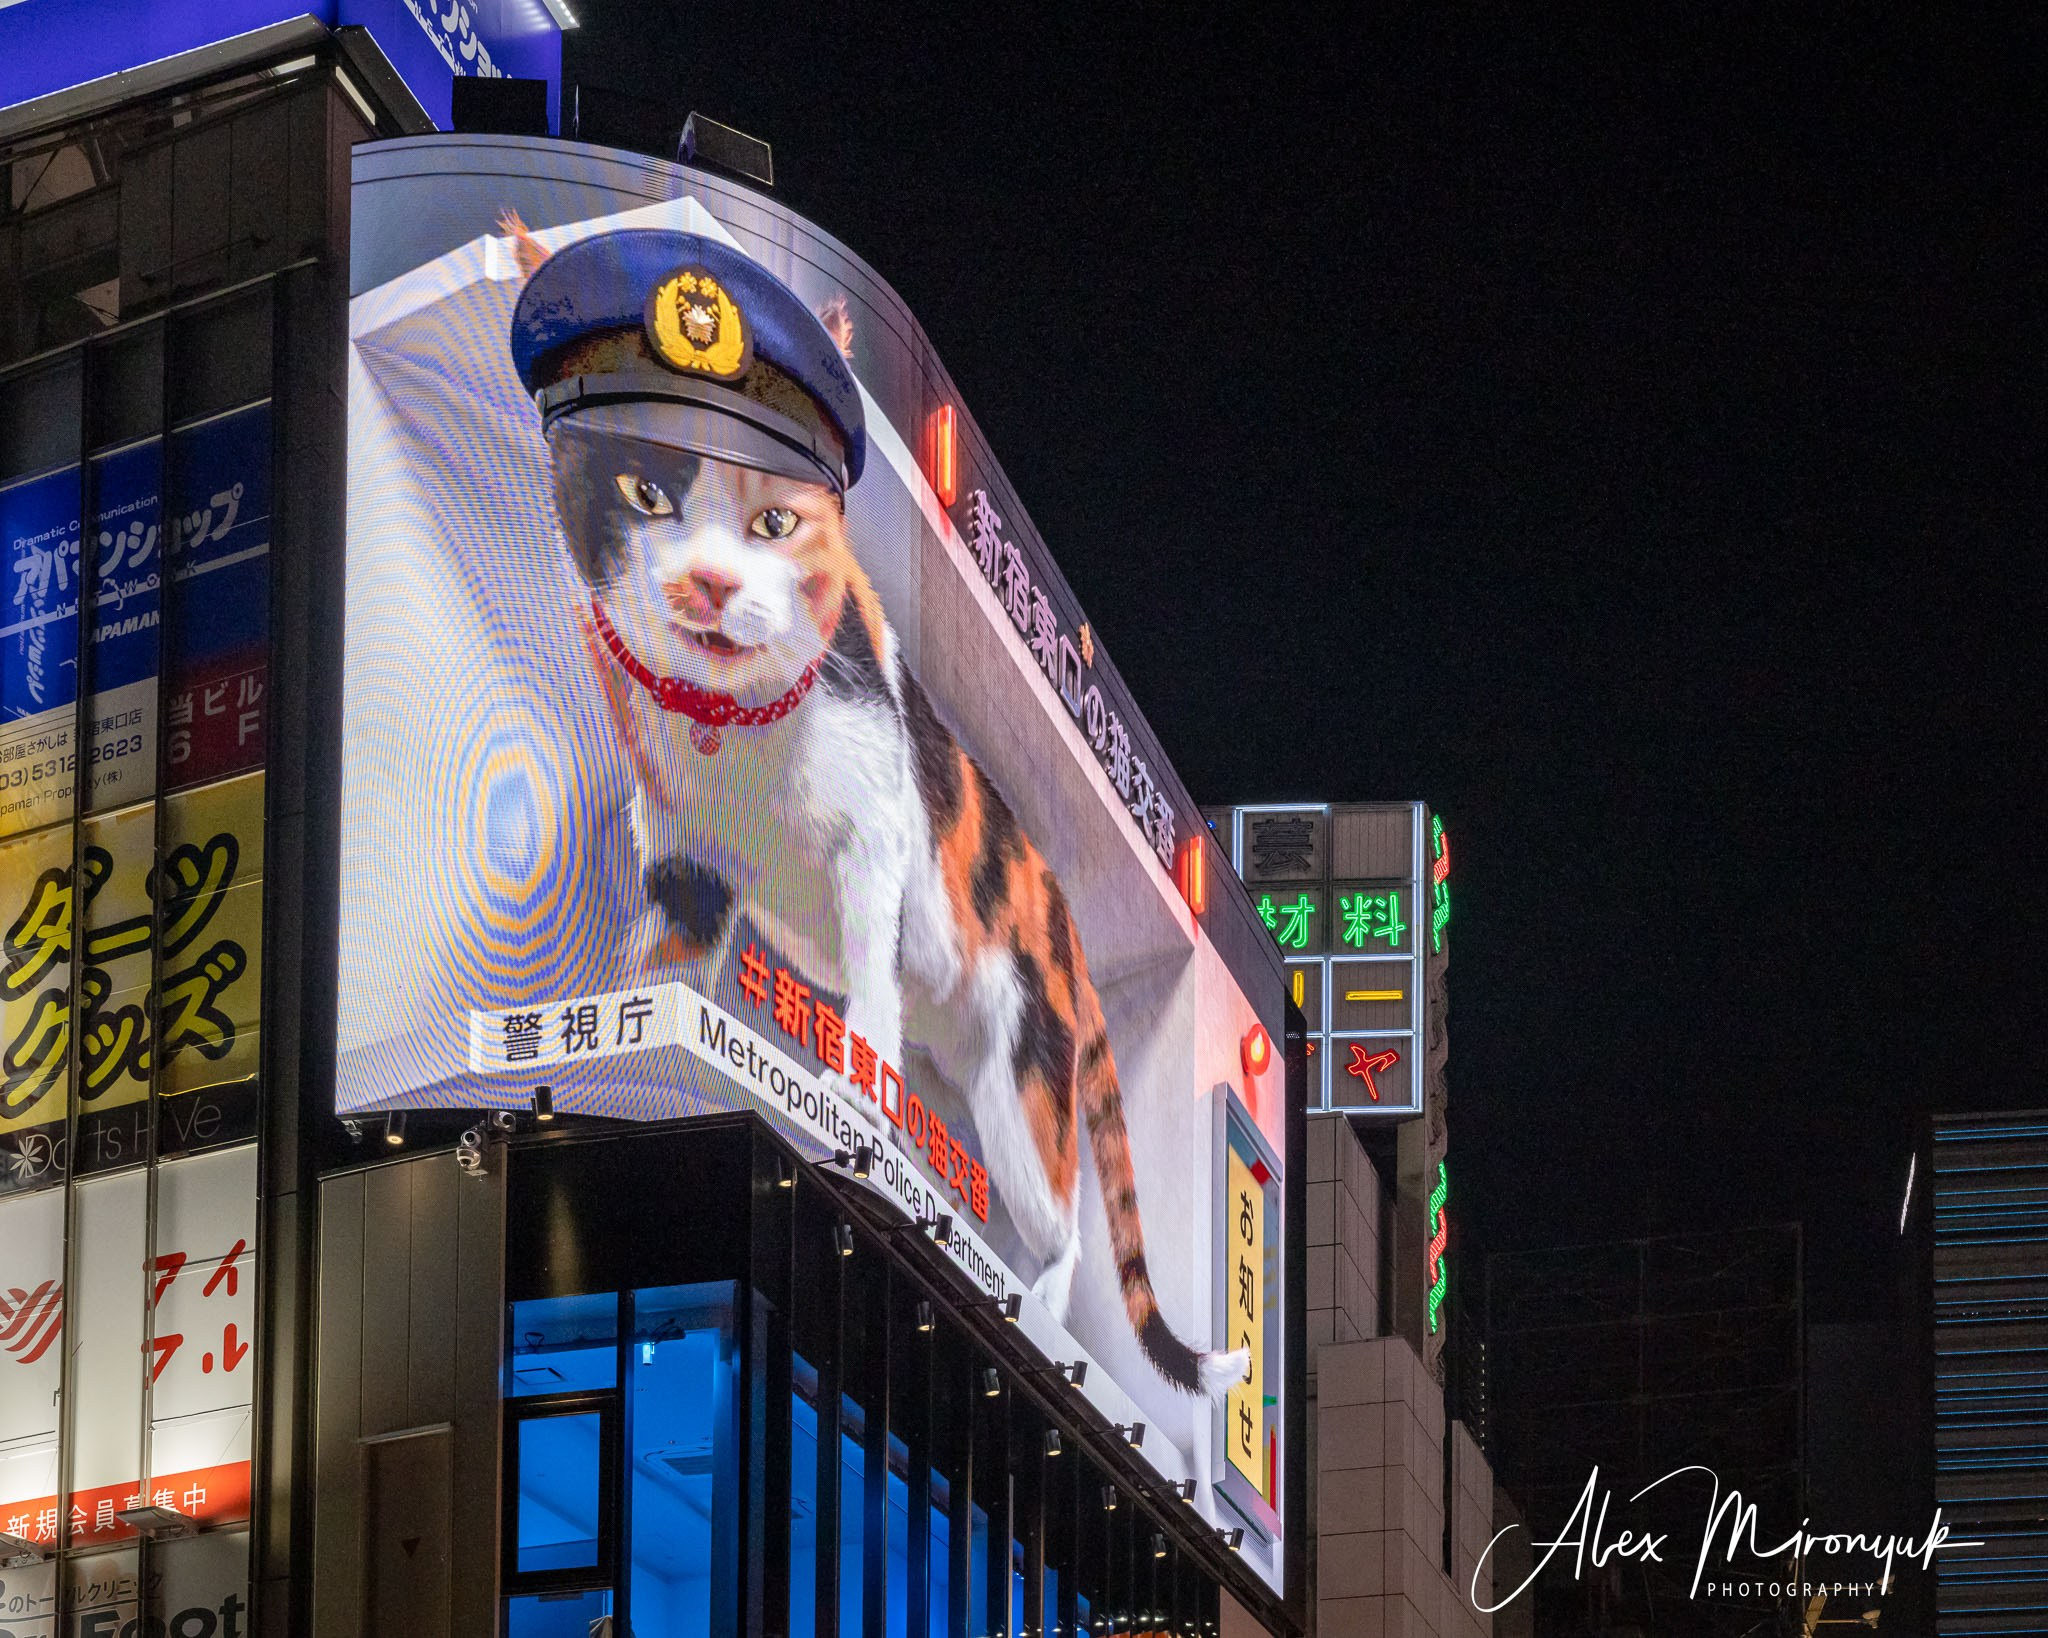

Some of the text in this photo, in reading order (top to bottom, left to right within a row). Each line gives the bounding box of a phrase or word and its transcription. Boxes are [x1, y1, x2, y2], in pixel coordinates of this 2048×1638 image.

[13, 495, 158, 551] Dramatic Cmunication
[13, 482, 244, 606] アパンシップ
[169, 675, 264, 724] 当ビル
[969, 489, 1176, 871] 新宿東口の猫交番
[74, 708, 143, 740] 宿東口店
[0, 734, 142, 792] 03)53122623
[0, 833, 239, 1000] ダーツ
[1257, 893, 1406, 948] 材料
[0, 940, 247, 1119] グッズ
[502, 996, 653, 1062] 警視庁
[700, 1005, 1007, 1302] Metropolitan Police Dpartment
